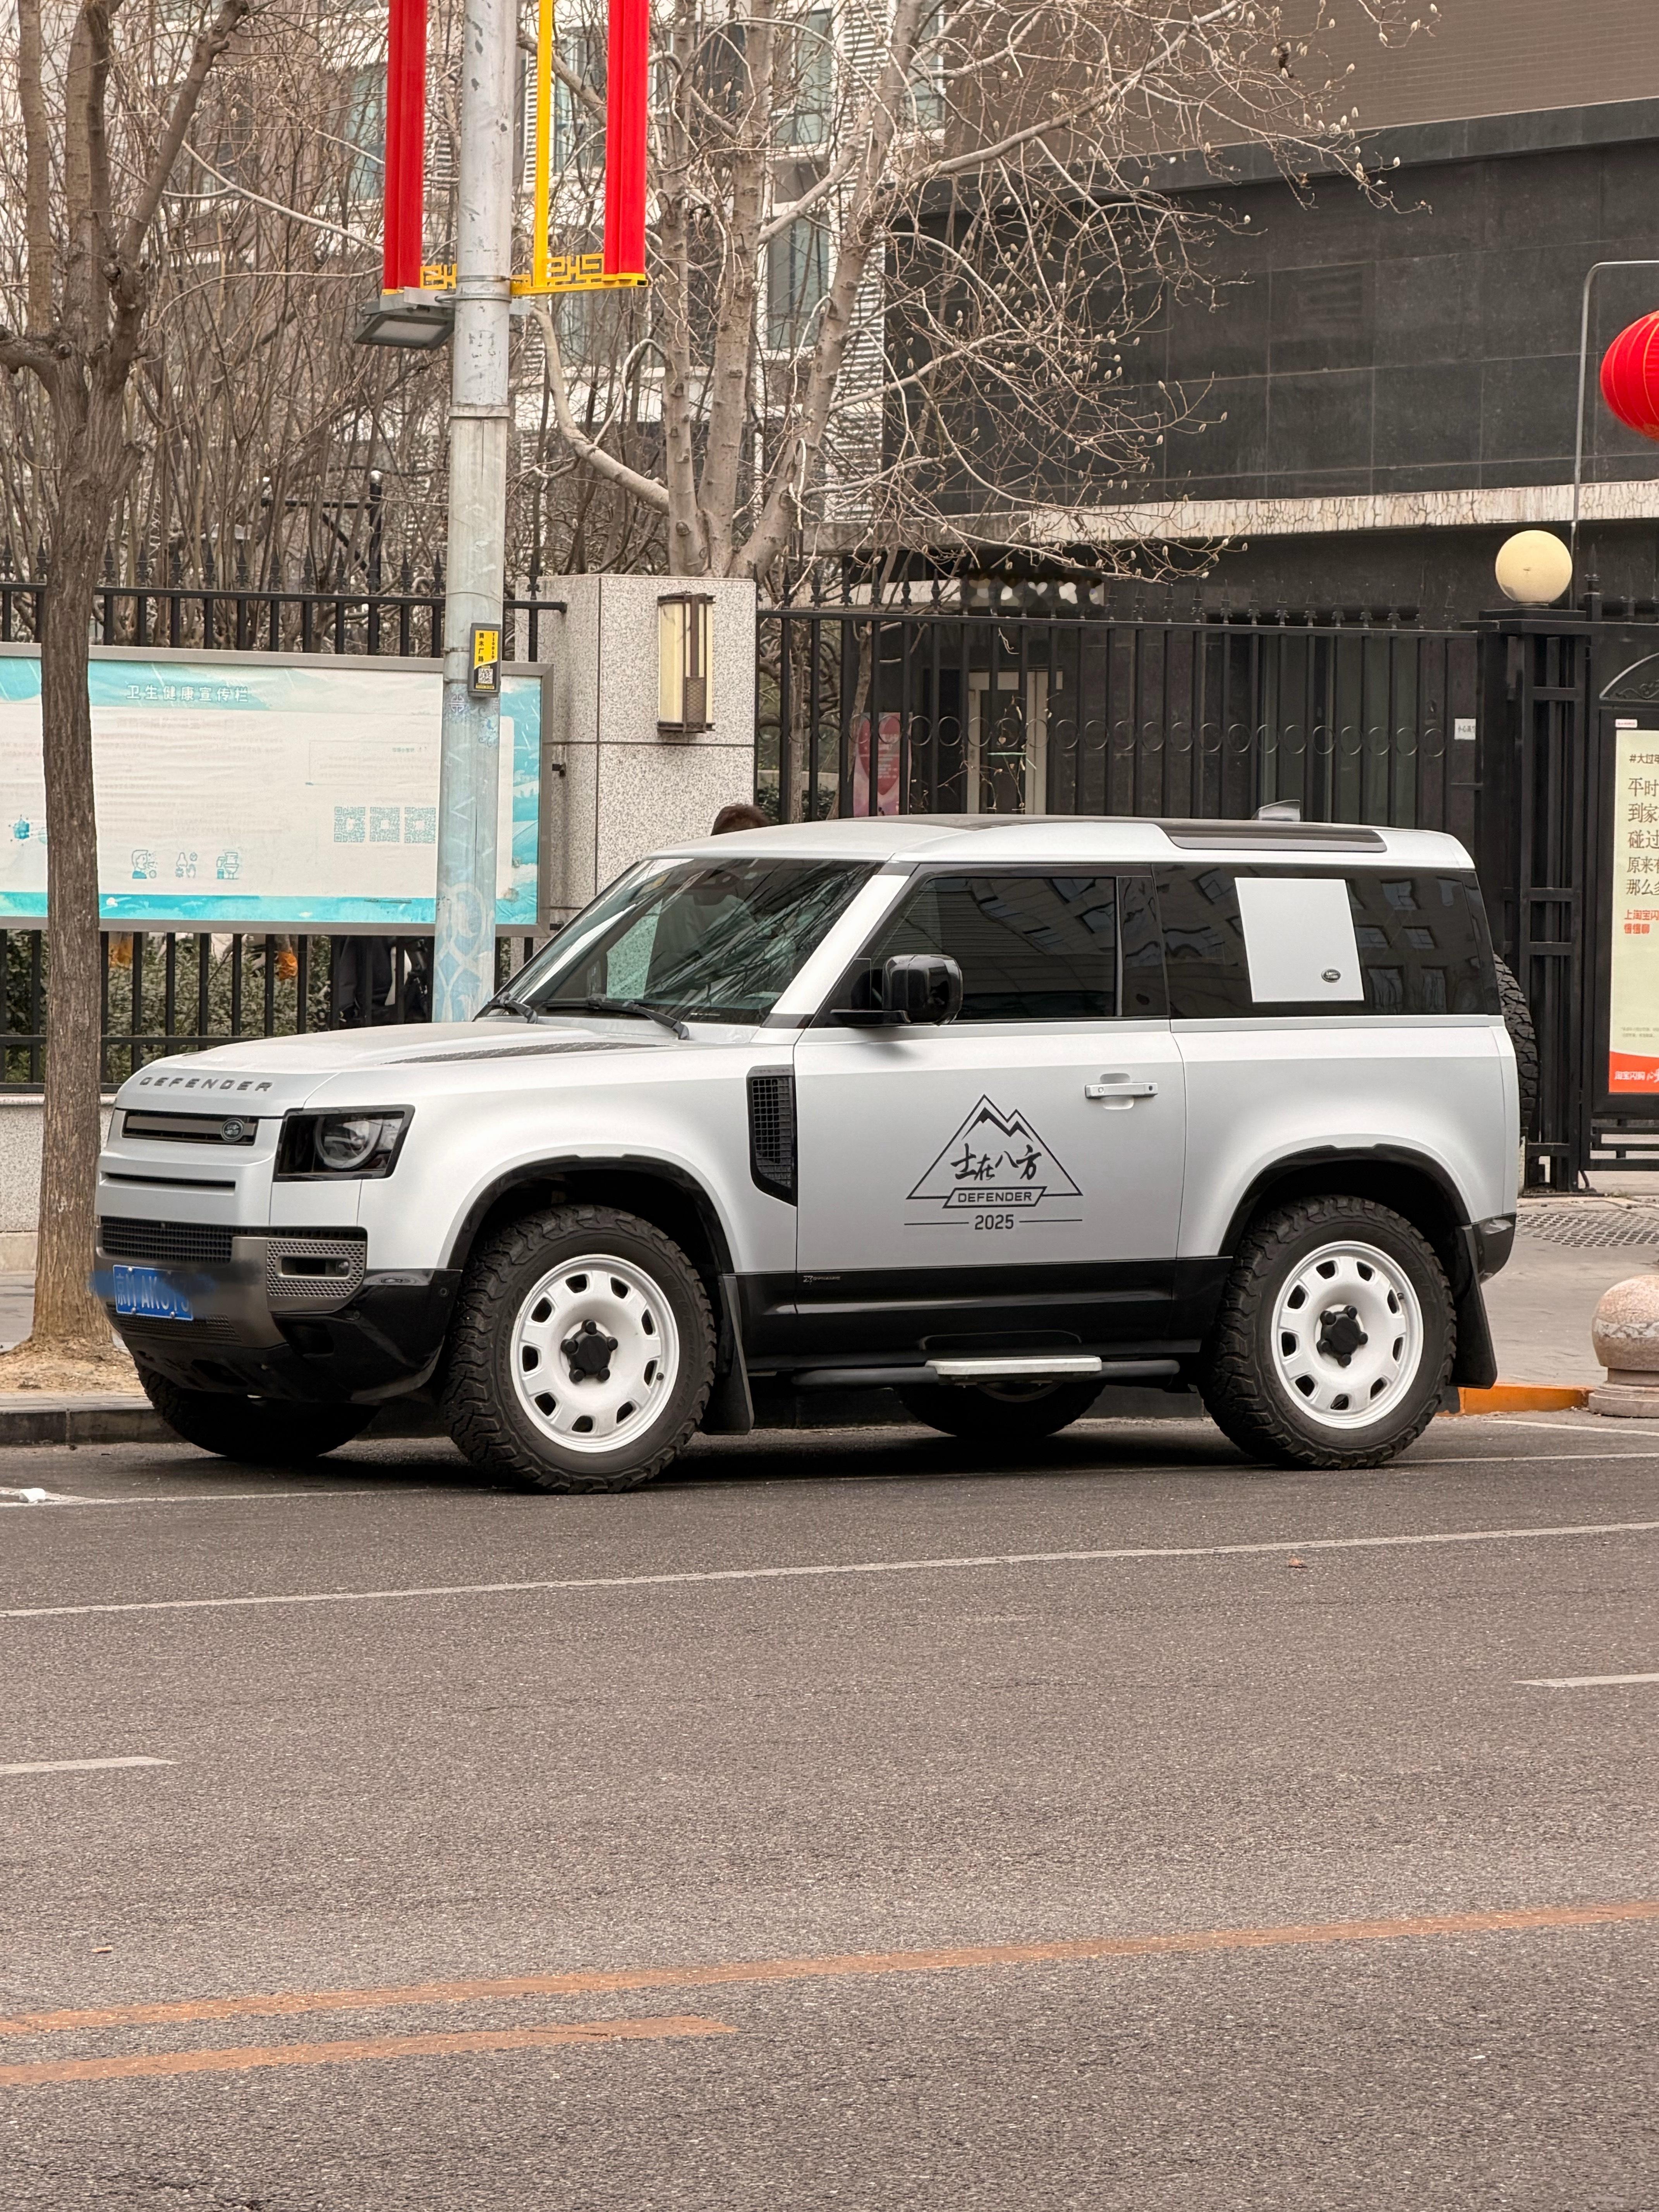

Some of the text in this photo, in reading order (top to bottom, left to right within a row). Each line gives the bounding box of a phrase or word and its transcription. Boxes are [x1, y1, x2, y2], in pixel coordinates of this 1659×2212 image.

[126, 684, 249, 702] 卫生健康宣传栏
[1628, 802, 1659, 823] 到家
[139, 1077, 273, 1092] DEFENDER
[958, 1192, 1032, 1202] DEFENDER
[974, 1214, 1014, 1230] 2025
